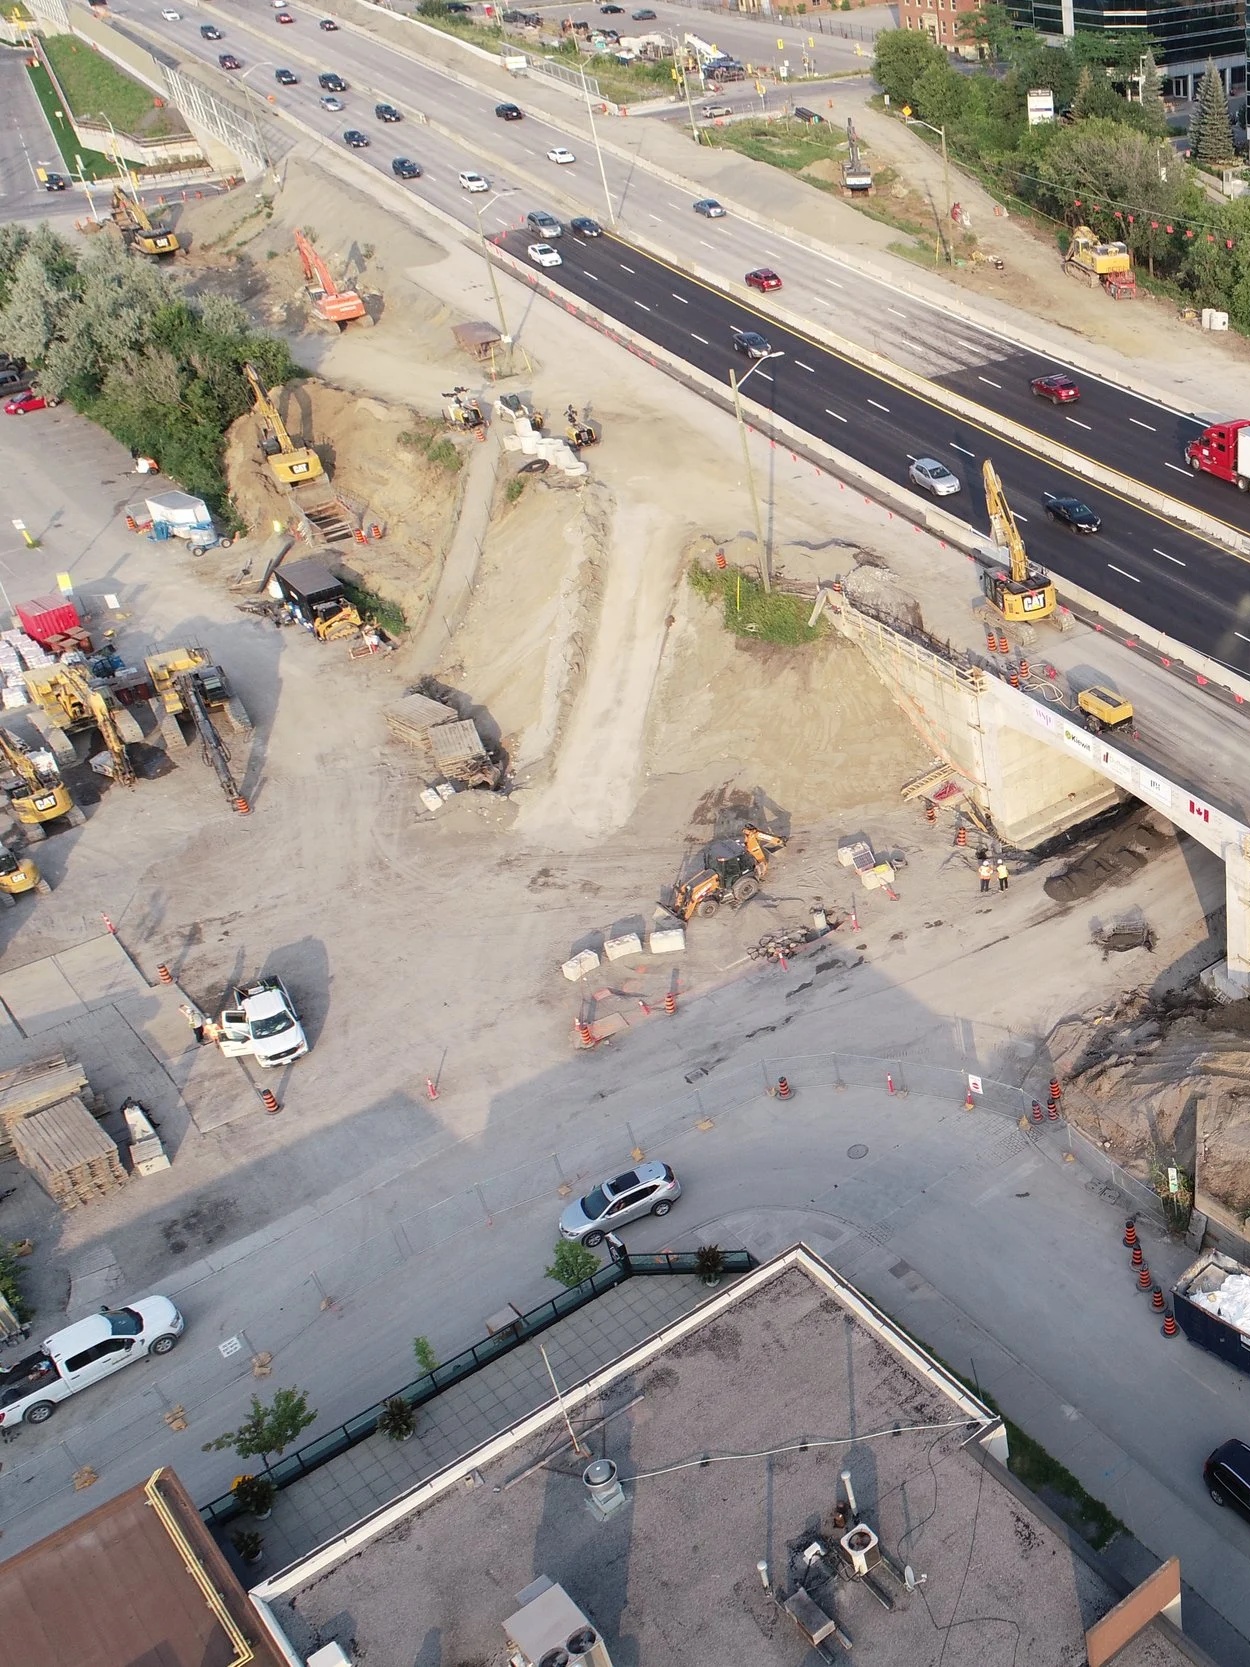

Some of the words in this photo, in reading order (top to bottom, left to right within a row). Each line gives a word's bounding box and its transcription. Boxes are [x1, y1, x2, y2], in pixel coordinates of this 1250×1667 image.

[292, 463, 308, 474] CAT
[1023, 593, 1045, 611] CAT
[1071, 734, 1091, 751] Kiewit
[34, 795, 57, 811] CAT
[11, 873, 26, 883] CAT
